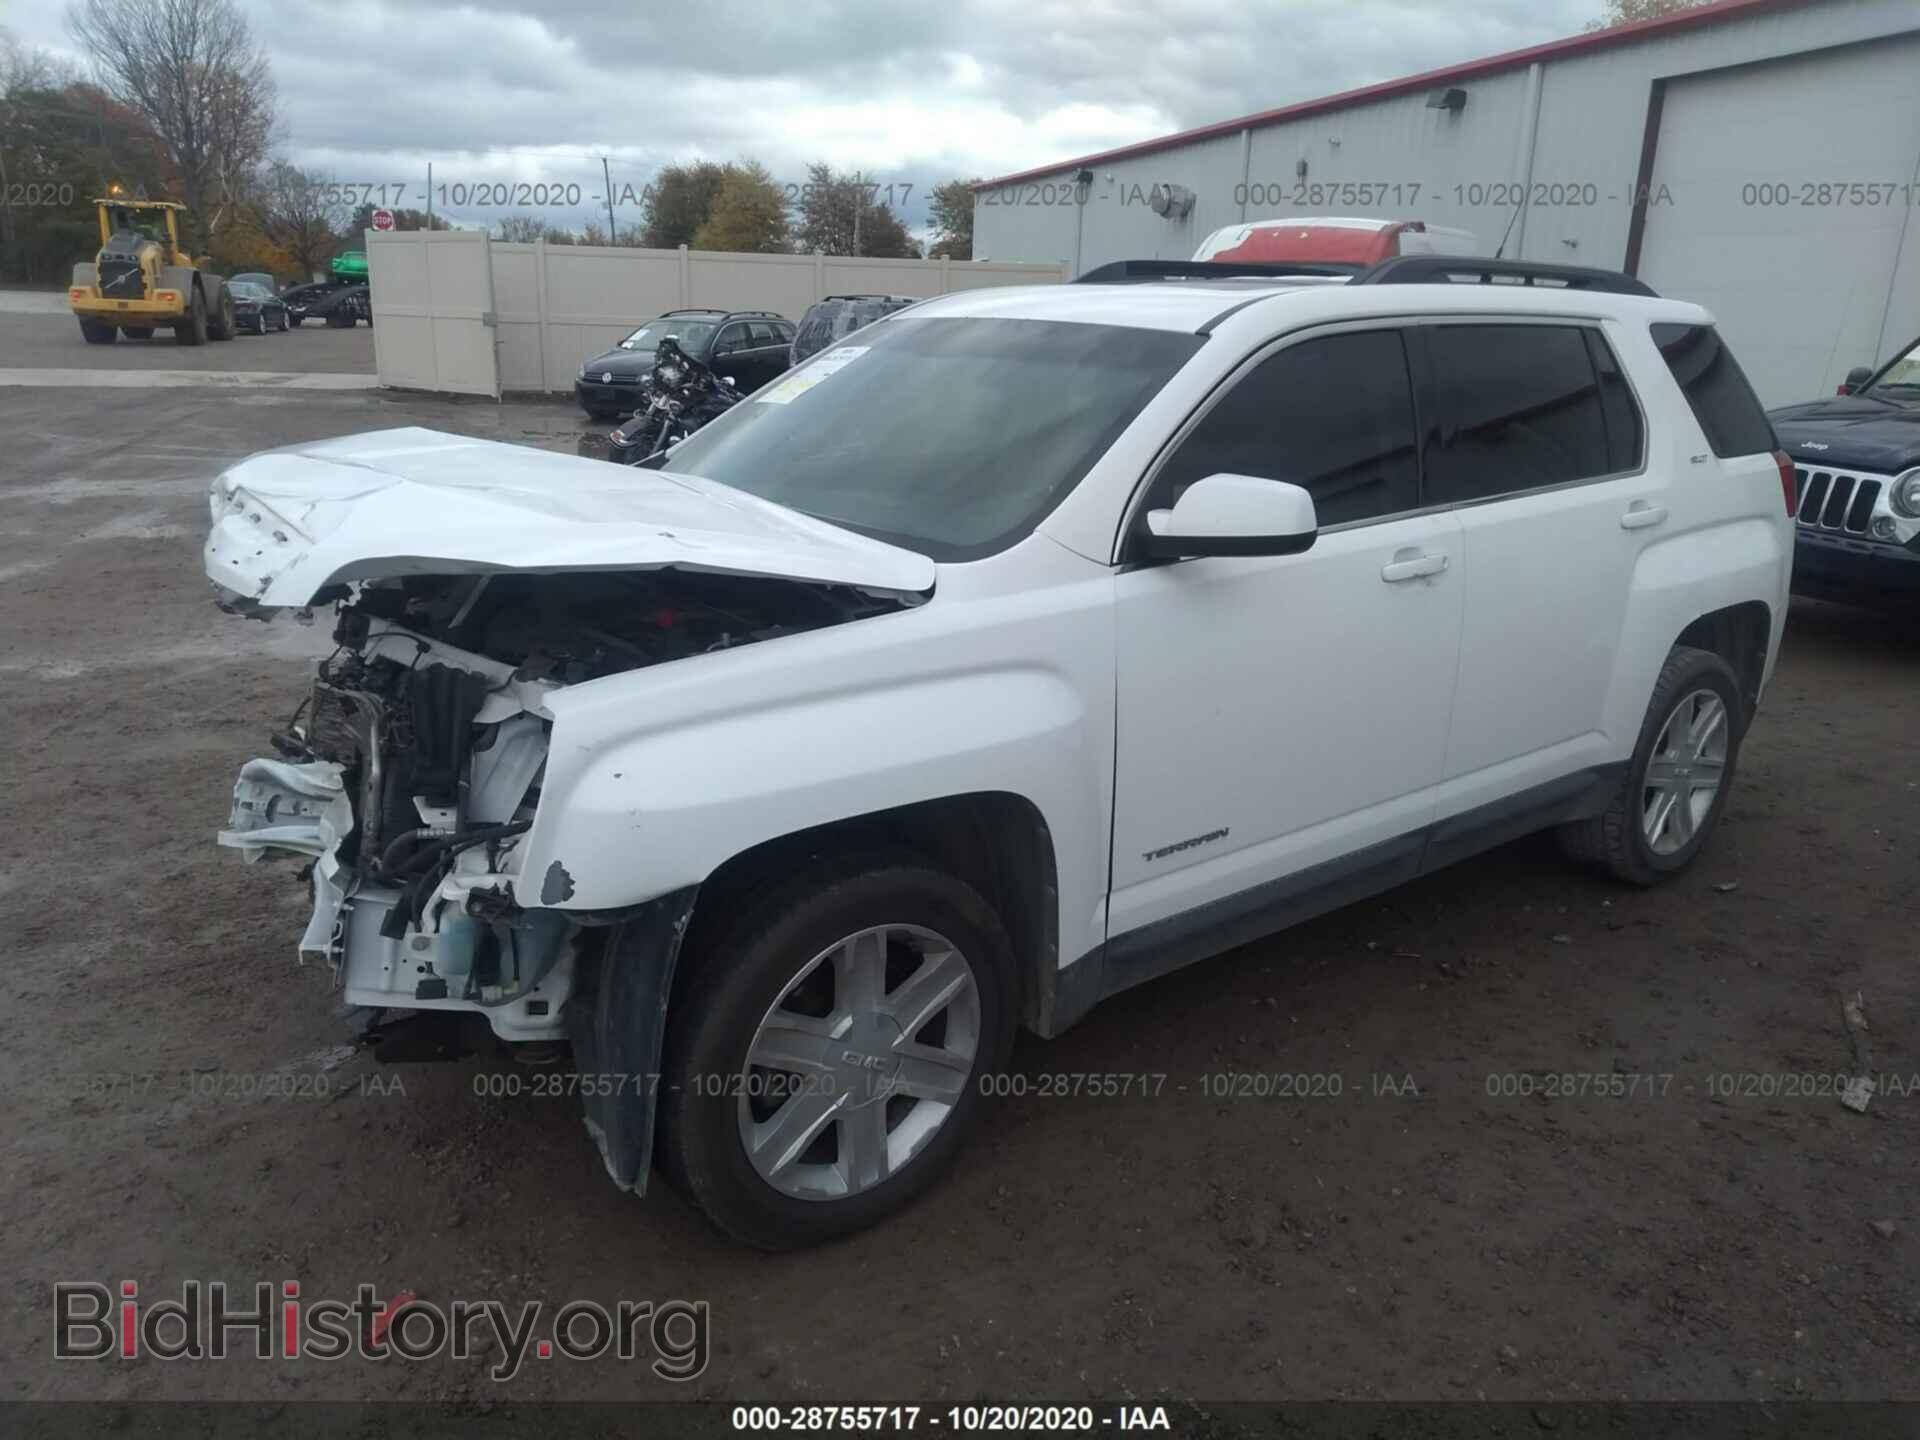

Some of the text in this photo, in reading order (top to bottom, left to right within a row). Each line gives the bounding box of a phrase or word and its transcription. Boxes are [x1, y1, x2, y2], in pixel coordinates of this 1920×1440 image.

[373, 215, 392, 226] STOP
[1142, 826, 1230, 862] TERRAIN
[841, 1050, 888, 1070] GMC
